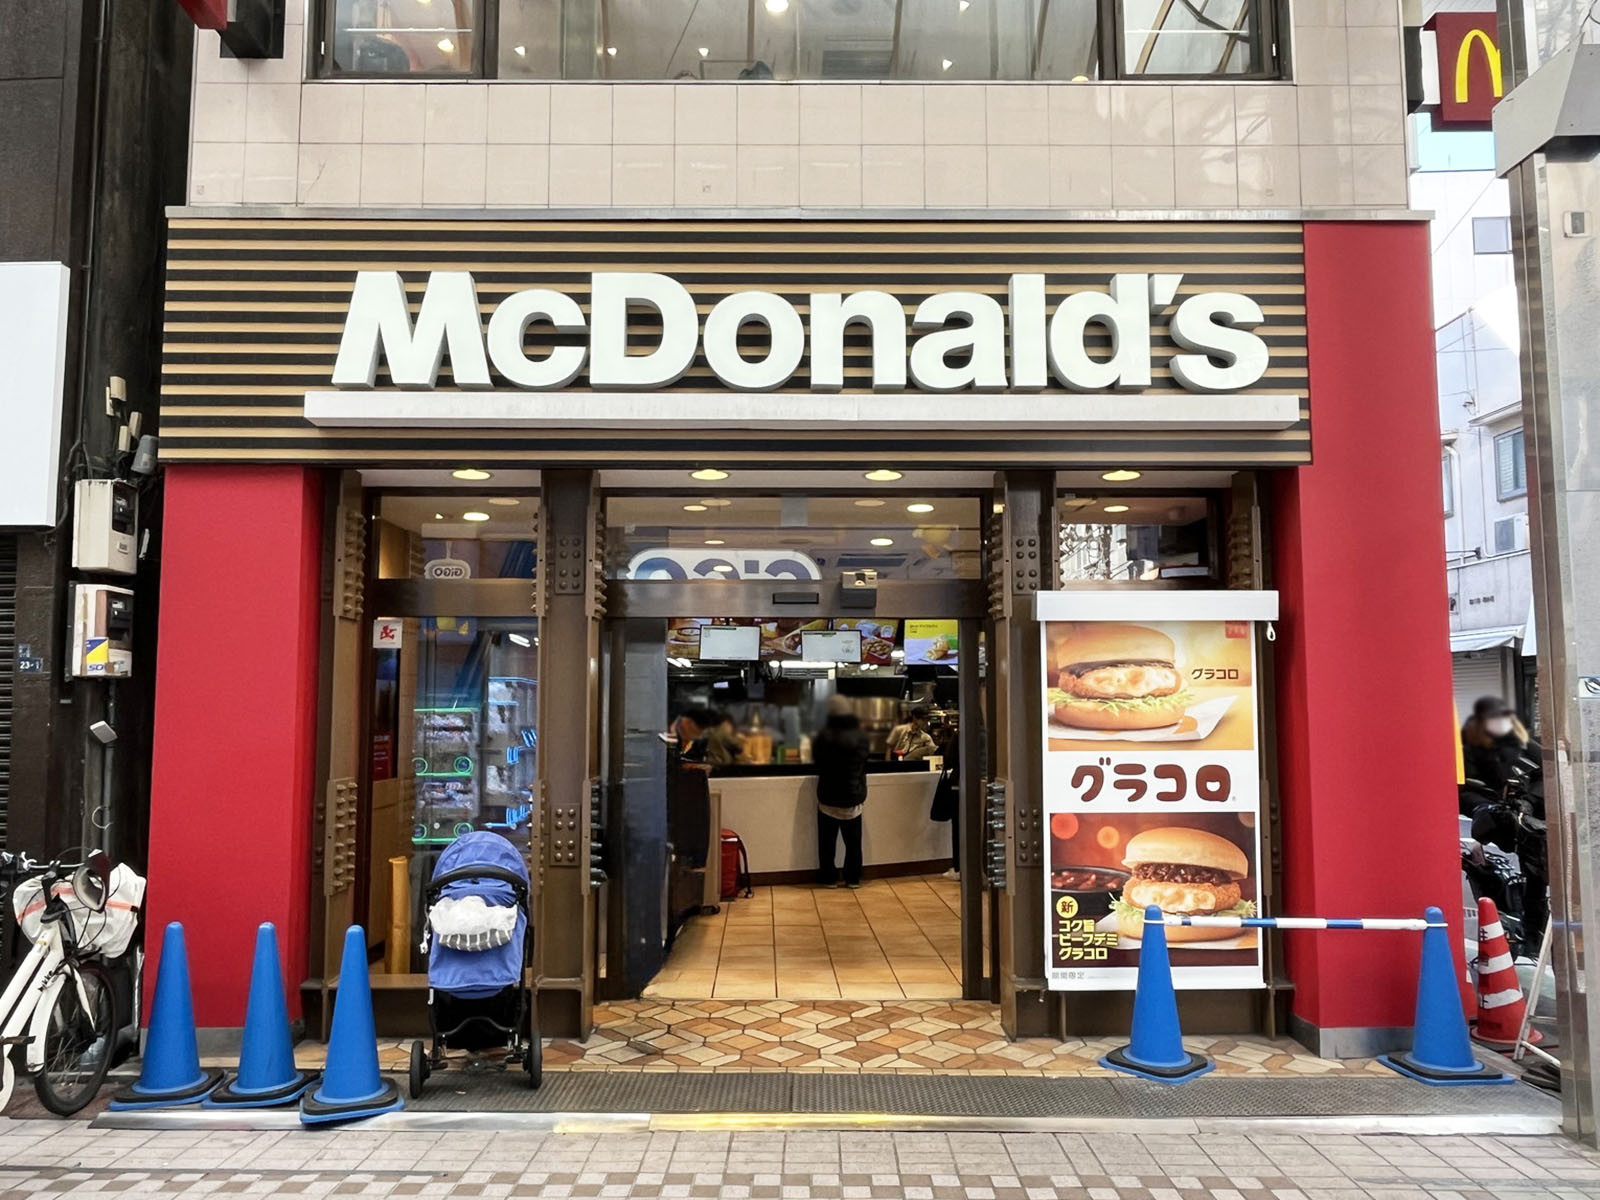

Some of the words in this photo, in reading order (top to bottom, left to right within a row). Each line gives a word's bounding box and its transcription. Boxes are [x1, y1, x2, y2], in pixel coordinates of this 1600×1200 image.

[332, 271, 1270, 391] McDonald's
[1191, 667, 1239, 680] グラコロ
[1071, 756, 1231, 803] グラコロ
[1060, 900, 1074, 914] 新
[1058, 933, 1119, 947] ビーフデミ
[1058, 947, 1108, 961] グラコロ
